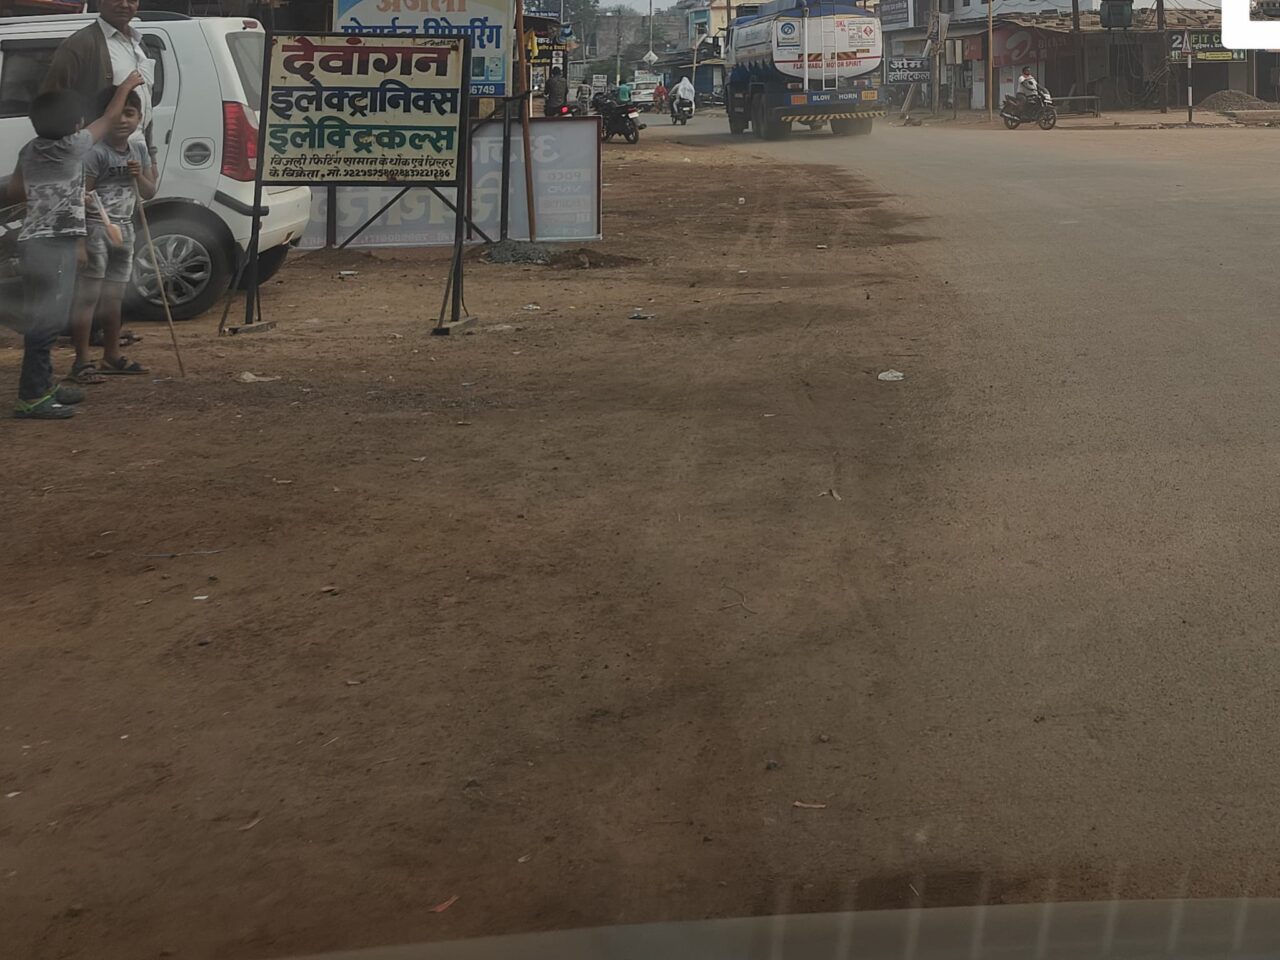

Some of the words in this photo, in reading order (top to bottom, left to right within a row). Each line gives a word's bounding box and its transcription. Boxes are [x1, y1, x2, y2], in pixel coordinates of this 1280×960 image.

[282, 36, 452, 84] देवांगन
[270, 79, 460, 120] इलेक्ट्रानिक्स
[471, 85, 496, 95] 6749
[268, 116, 457, 154] इलेक्ट्रिकल्स
[268, 168, 279, 177] के
[343, 157, 377, 167] सामान
